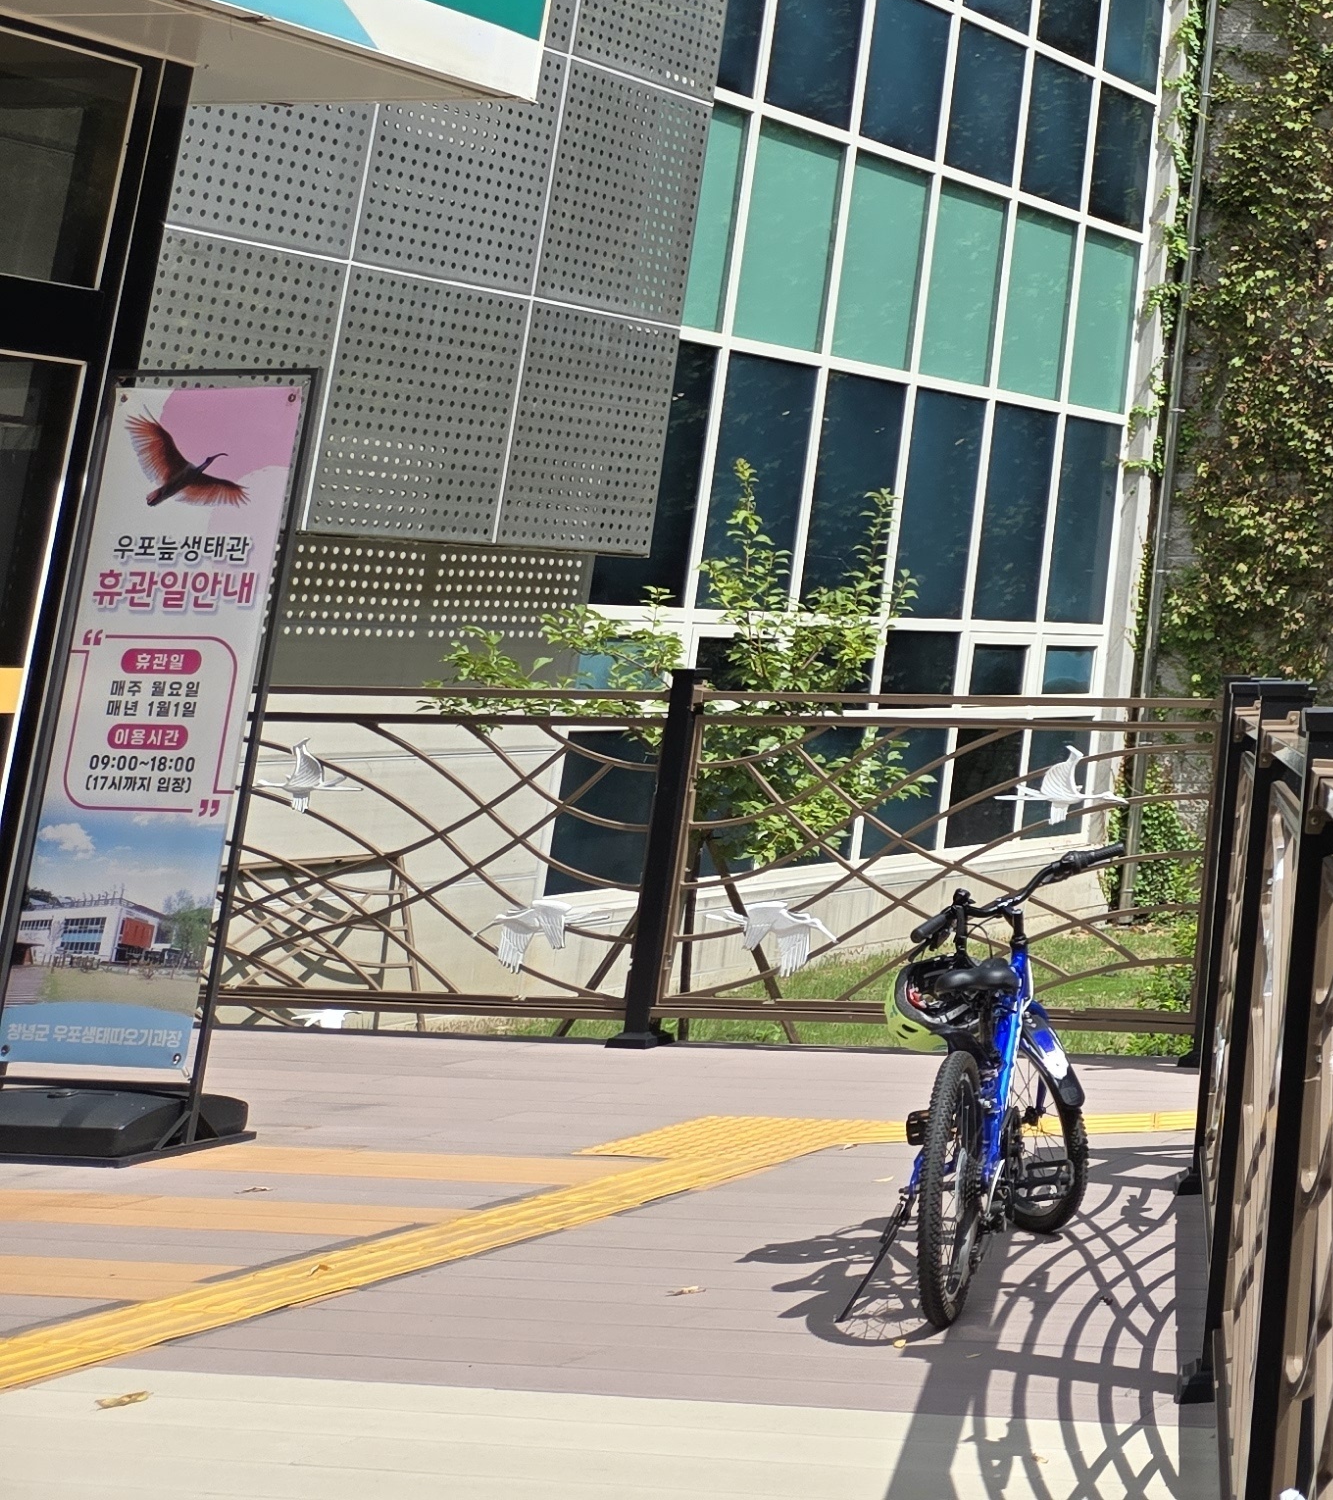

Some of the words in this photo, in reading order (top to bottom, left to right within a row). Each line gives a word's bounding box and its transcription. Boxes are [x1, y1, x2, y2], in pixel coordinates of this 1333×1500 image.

[113, 535, 250, 562] 우포늪생태관
[92, 569, 255, 609] 휴관일안내
[135, 653, 185, 670] 휴관일
[110, 680, 142, 697] 매주
[151, 680, 200, 698] 월요일
[106, 700, 138, 717] 매년
[147, 701, 197, 718] 1월1일
[114, 728, 180, 746] 이용시간
[88, 754, 196, 773] 09:00~18:00
[85, 774, 151, 792] (17시까지
[156, 776, 192, 794] 입장)
[7, 1023, 50, 1042] 창녕군
[53, 1025, 182, 1048] 우포생태따오기과장
